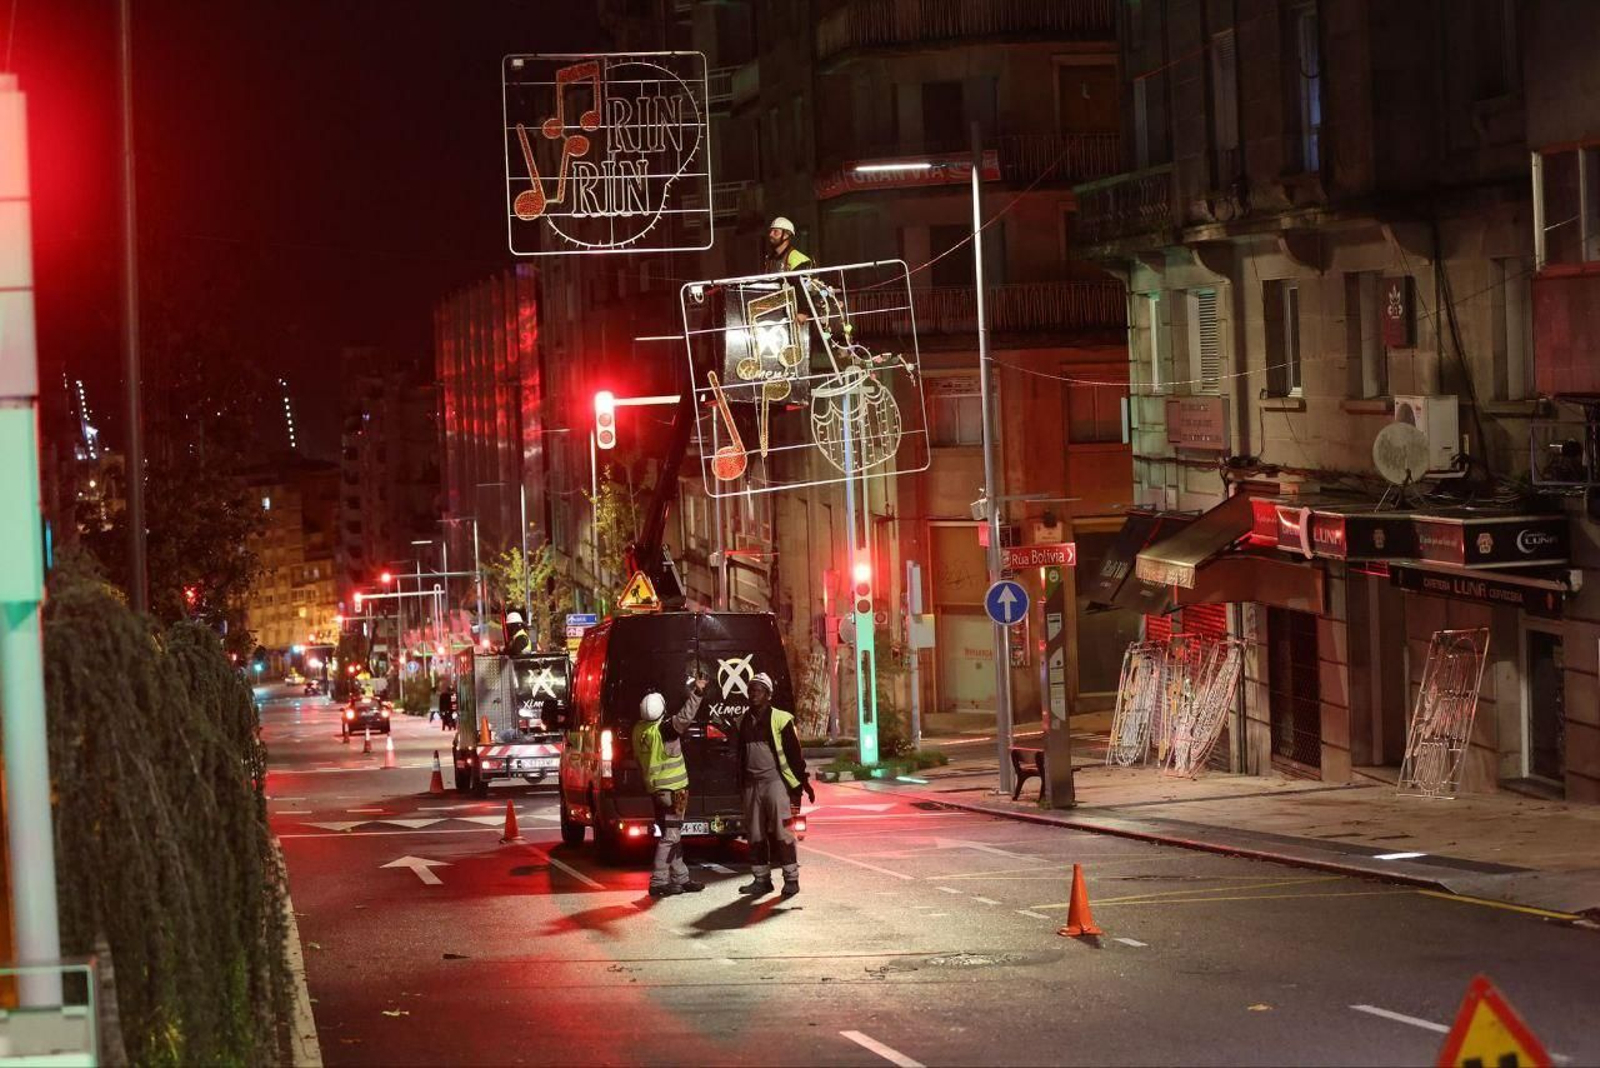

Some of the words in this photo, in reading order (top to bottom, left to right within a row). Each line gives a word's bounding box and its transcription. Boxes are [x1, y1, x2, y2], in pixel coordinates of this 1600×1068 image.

[605, 96, 683, 153] RIN
[571, 160, 650, 217] RIN
[1313, 526, 1343, 547] LUNA
[1031, 549, 1065, 564] Bolivia
[1453, 579, 1487, 599] LUNA
